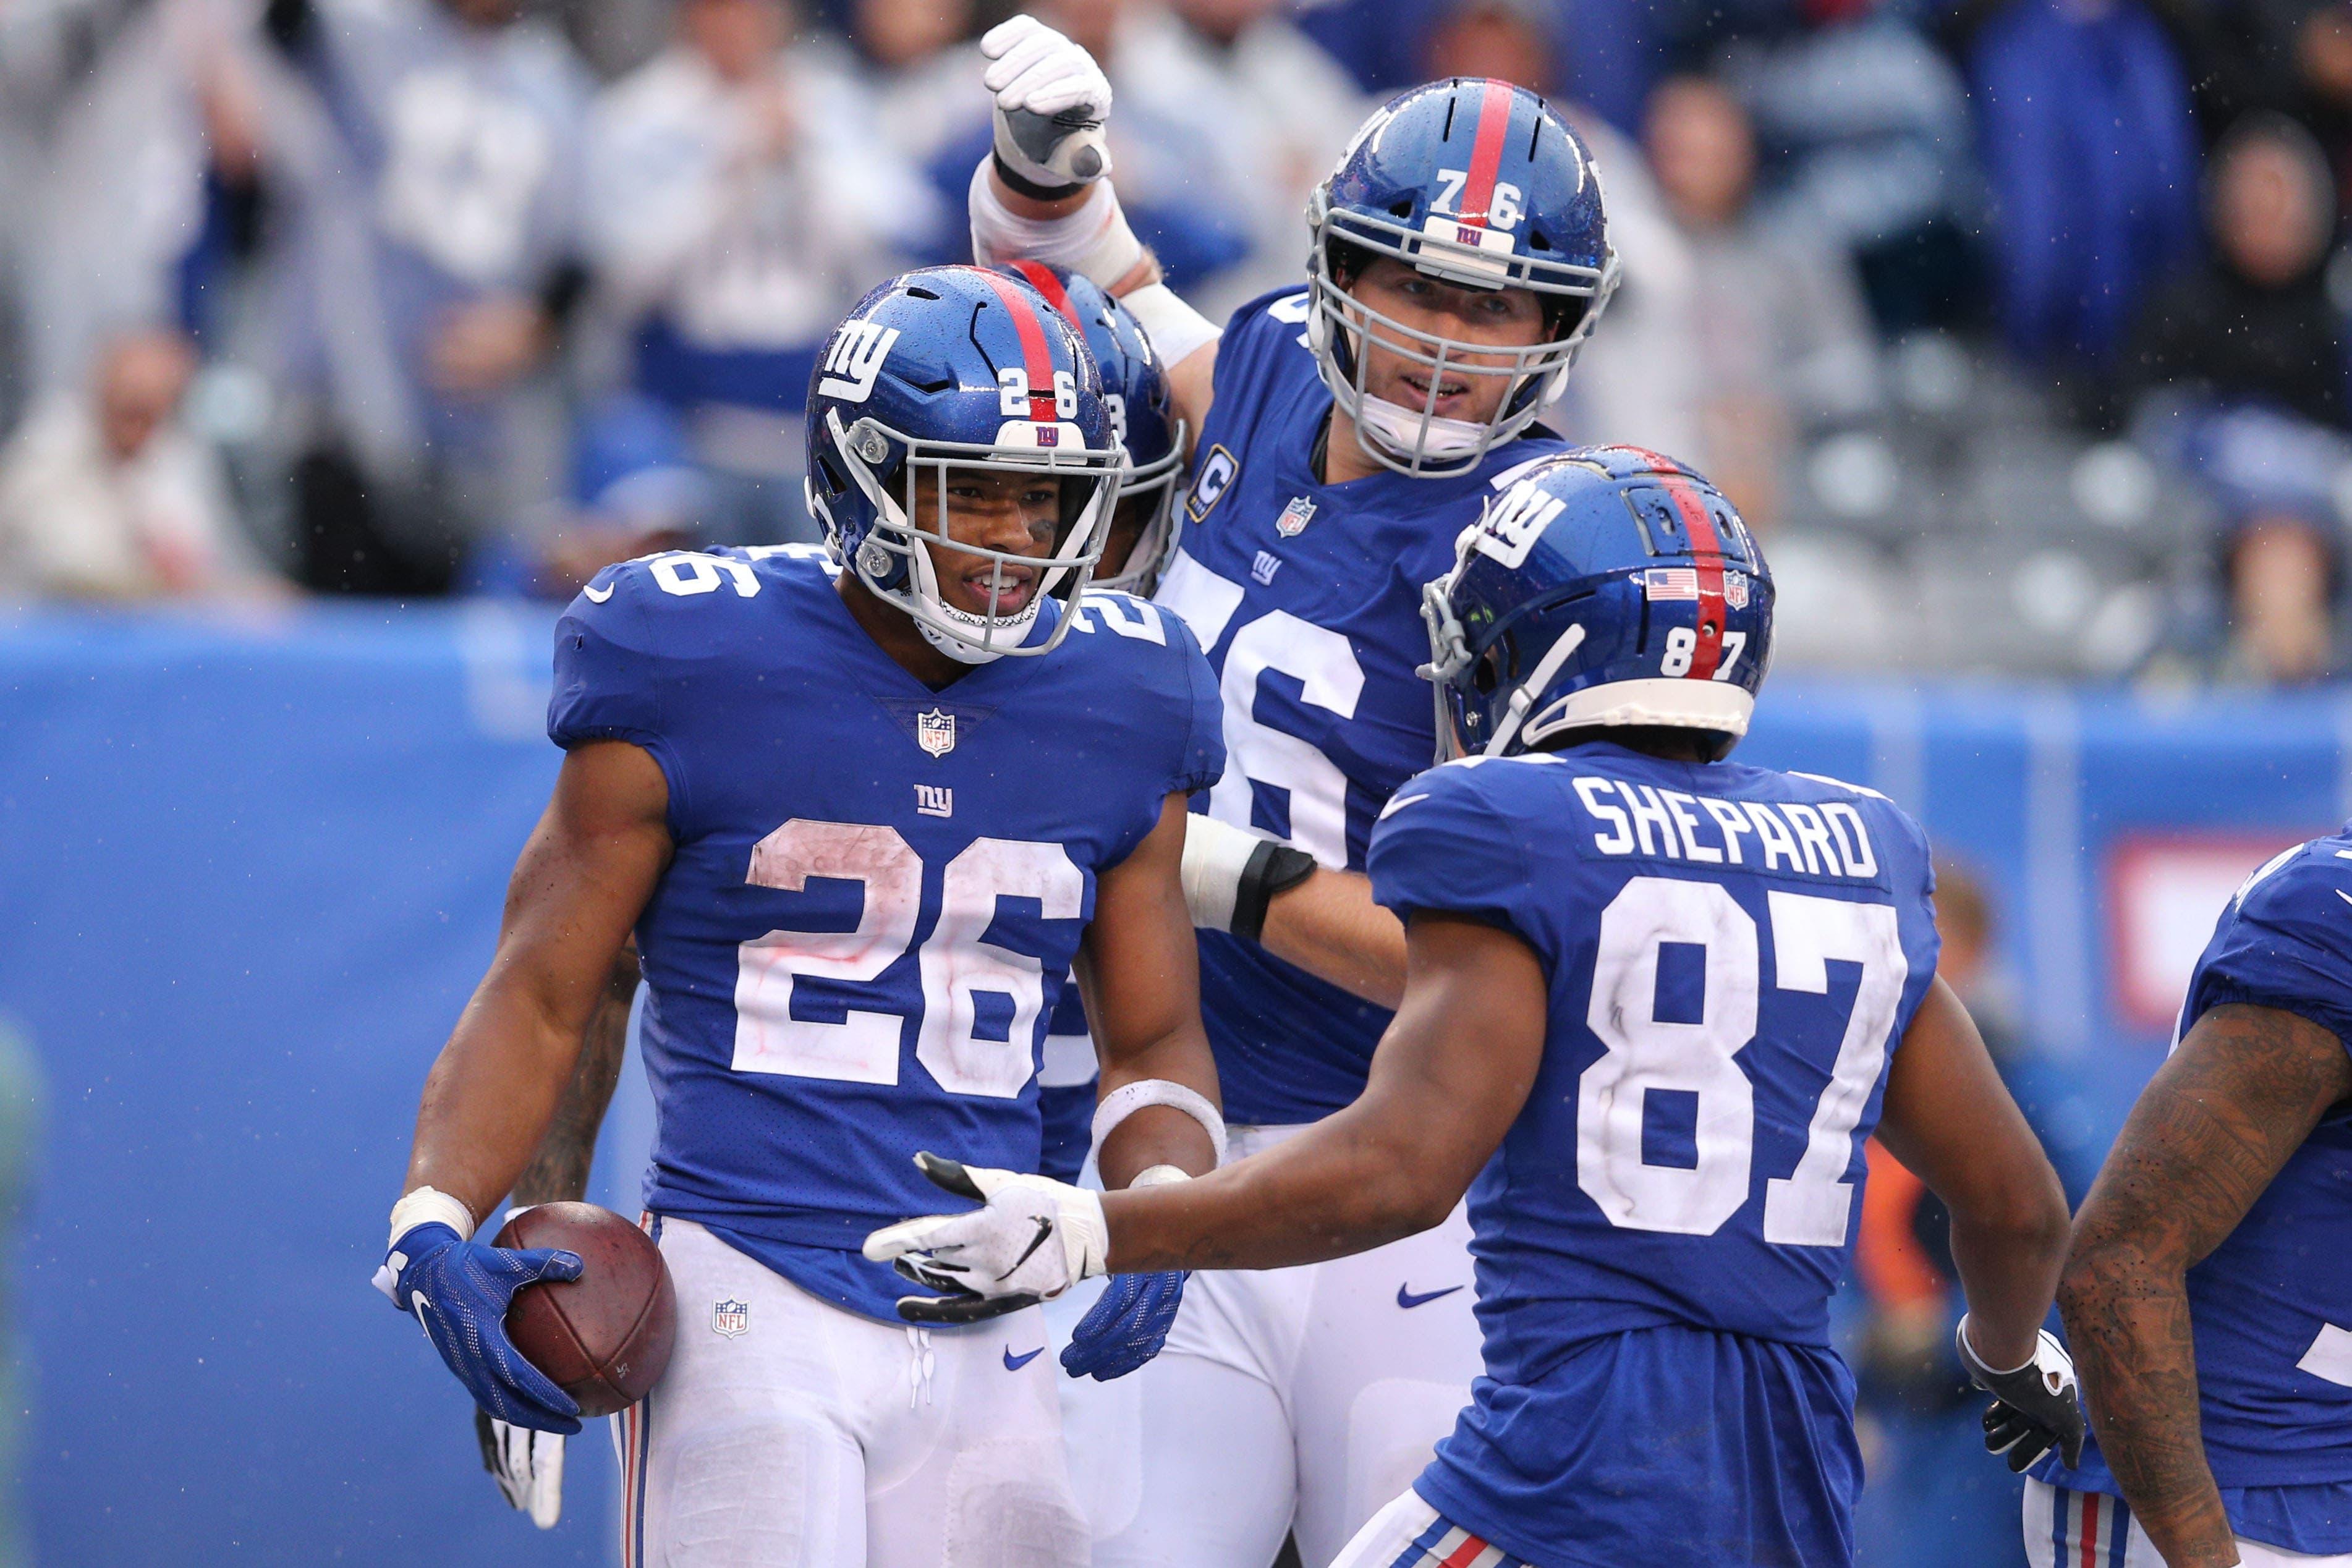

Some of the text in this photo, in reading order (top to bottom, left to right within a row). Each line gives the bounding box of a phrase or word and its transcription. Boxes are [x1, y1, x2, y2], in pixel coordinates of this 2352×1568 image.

[1430, 168, 1522, 231] 76
[998, 367, 1077, 419] 26
[1198, 453, 1232, 504] C
[1728, 587, 1747, 604] NFL
[1660, 625, 1747, 680] 87
[925, 730, 949, 748] NFL
[1572, 777, 1879, 878] SHEPARD
[731, 818, 1084, 1099] 26
[1577, 875, 1909, 1247] 87
[718, 1313, 744, 1331] NFL
